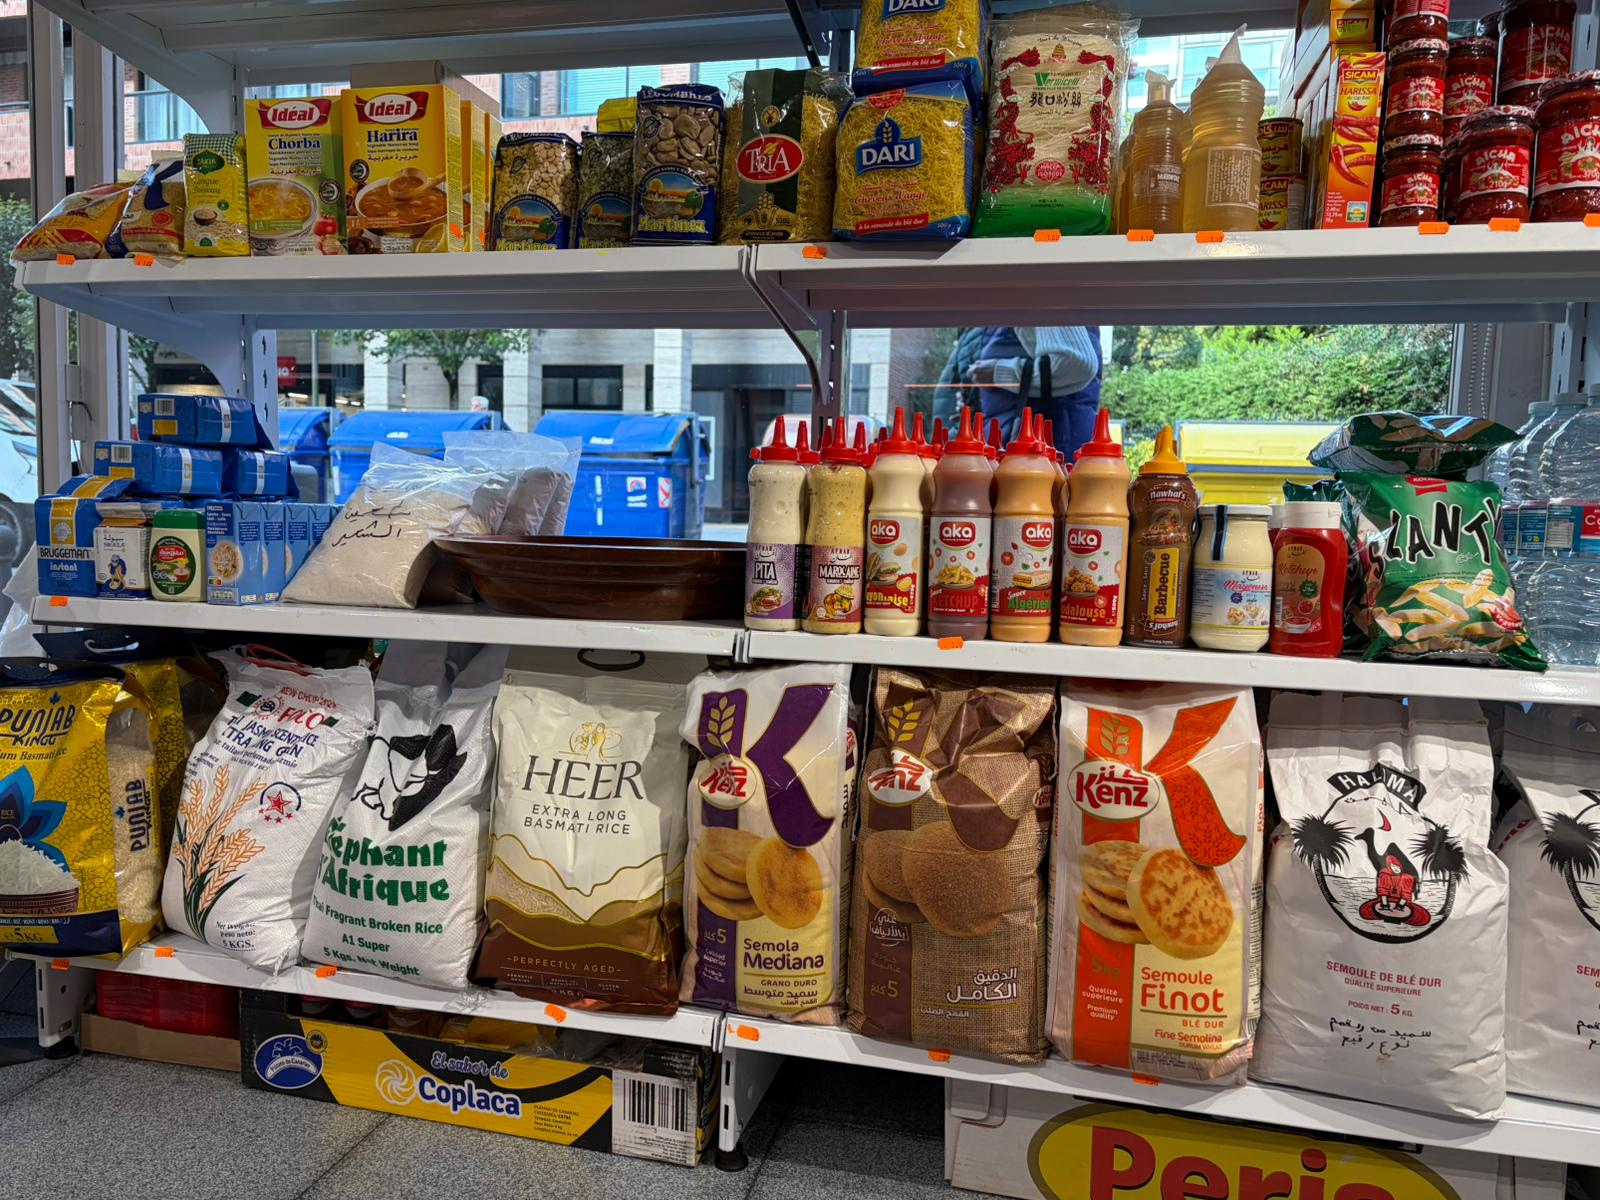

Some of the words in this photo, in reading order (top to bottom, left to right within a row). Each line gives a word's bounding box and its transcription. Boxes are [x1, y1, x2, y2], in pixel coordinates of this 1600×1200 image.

[1344, 71, 1376, 80] SICAM
[1451, 76, 1486, 91] AICHA
[1340, 87, 1377, 96] HARISSA
[271, 106, 314, 123] Idéal
[369, 99, 411, 117] Idéal
[269, 138, 320, 149] Chorba
[367, 128, 418, 142] Harira
[862, 143, 915, 166] DARI
[1475, 148, 1516, 166] AICHA
[1261, 182, 1287, 195] ICAM
[872, 521, 897, 537] aka
[942, 524, 973, 539] aka
[1026, 524, 1051, 539] aka
[1070, 533, 1098, 546] aka
[40, 548, 90, 559] BRUGGEMAN
[755, 562, 777, 580] PITA
[1153, 552, 1171, 616] Barbecue
[1008, 589, 1026, 600] Sauce
[0, 703, 76, 733] PUNJAB
[521, 754, 644, 800] HEER
[1076, 771, 1149, 809] Kenz
[1338, 772, 1419, 803] HALIMA
[125, 779, 147, 852] PUNJAB
[532, 803, 580, 821] EXTRA
[587, 810, 627, 822] LONG
[524, 816, 590, 834] BASMATI
[596, 823, 631, 835] RICE
[325, 906, 367, 928] Fragrant
[368, 917, 411, 934] Broken
[414, 921, 443, 934] Rice
[236, 930, 256, 939] neto:
[342, 933, 355, 946] A1
[357, 936, 391, 954] Super
[228, 939, 255, 950] KGS.
[743, 938, 799, 951] Semola
[323, 946, 330, 957] 5
[331, 948, 356, 963] Kgs.
[378, 960, 420, 977] Weight
[513, 955, 577, 970] PERFECTLY
[583, 963, 615, 974] AGED
[743, 953, 825, 971] Mediana
[760, 979, 791, 988] GRANO
[793, 978, 818, 987] DURO
[973, 967, 1018, 986] الدقيق
[1141, 966, 1214, 985] Semoule
[1326, 960, 1377, 981] SEMOULE
[1379, 971, 1394, 982] DE
[1396, 973, 1418, 986] BLÉ
[1419, 977, 1442, 988] DUR
[743, 985, 784, 999] متوسط
[785, 989, 818, 999] سميد
[887, 980, 898, 998] 5
[946, 981, 1018, 1004] الكامل
[1088, 984, 1118, 996] Qualité
[1344, 977, 1374, 990] QUALITÉ
[1376, 984, 1422, 997] SUPERIEURE
[1140, 983, 1225, 1013] Finot
[1087, 1003, 1118, 1016] Premium
[1090, 1012, 1115, 1021] quality
[1348, 1000, 1370, 1011] POIDS
[1371, 1004, 1385, 1013] NET
[1390, 1003, 1401, 1016] 5
[1181, 1018, 1201, 1028] BLÉ
[1204, 1020, 1225, 1029] DUR
[1154, 1028, 1176, 1041] Fine
[1177, 1031, 1223, 1043] Semolina
[431, 1051, 448, 1069] El
[448, 1054, 489, 1075] sabor
[490, 1060, 509, 1079] de
[418, 1076, 522, 1117] Coplaca
